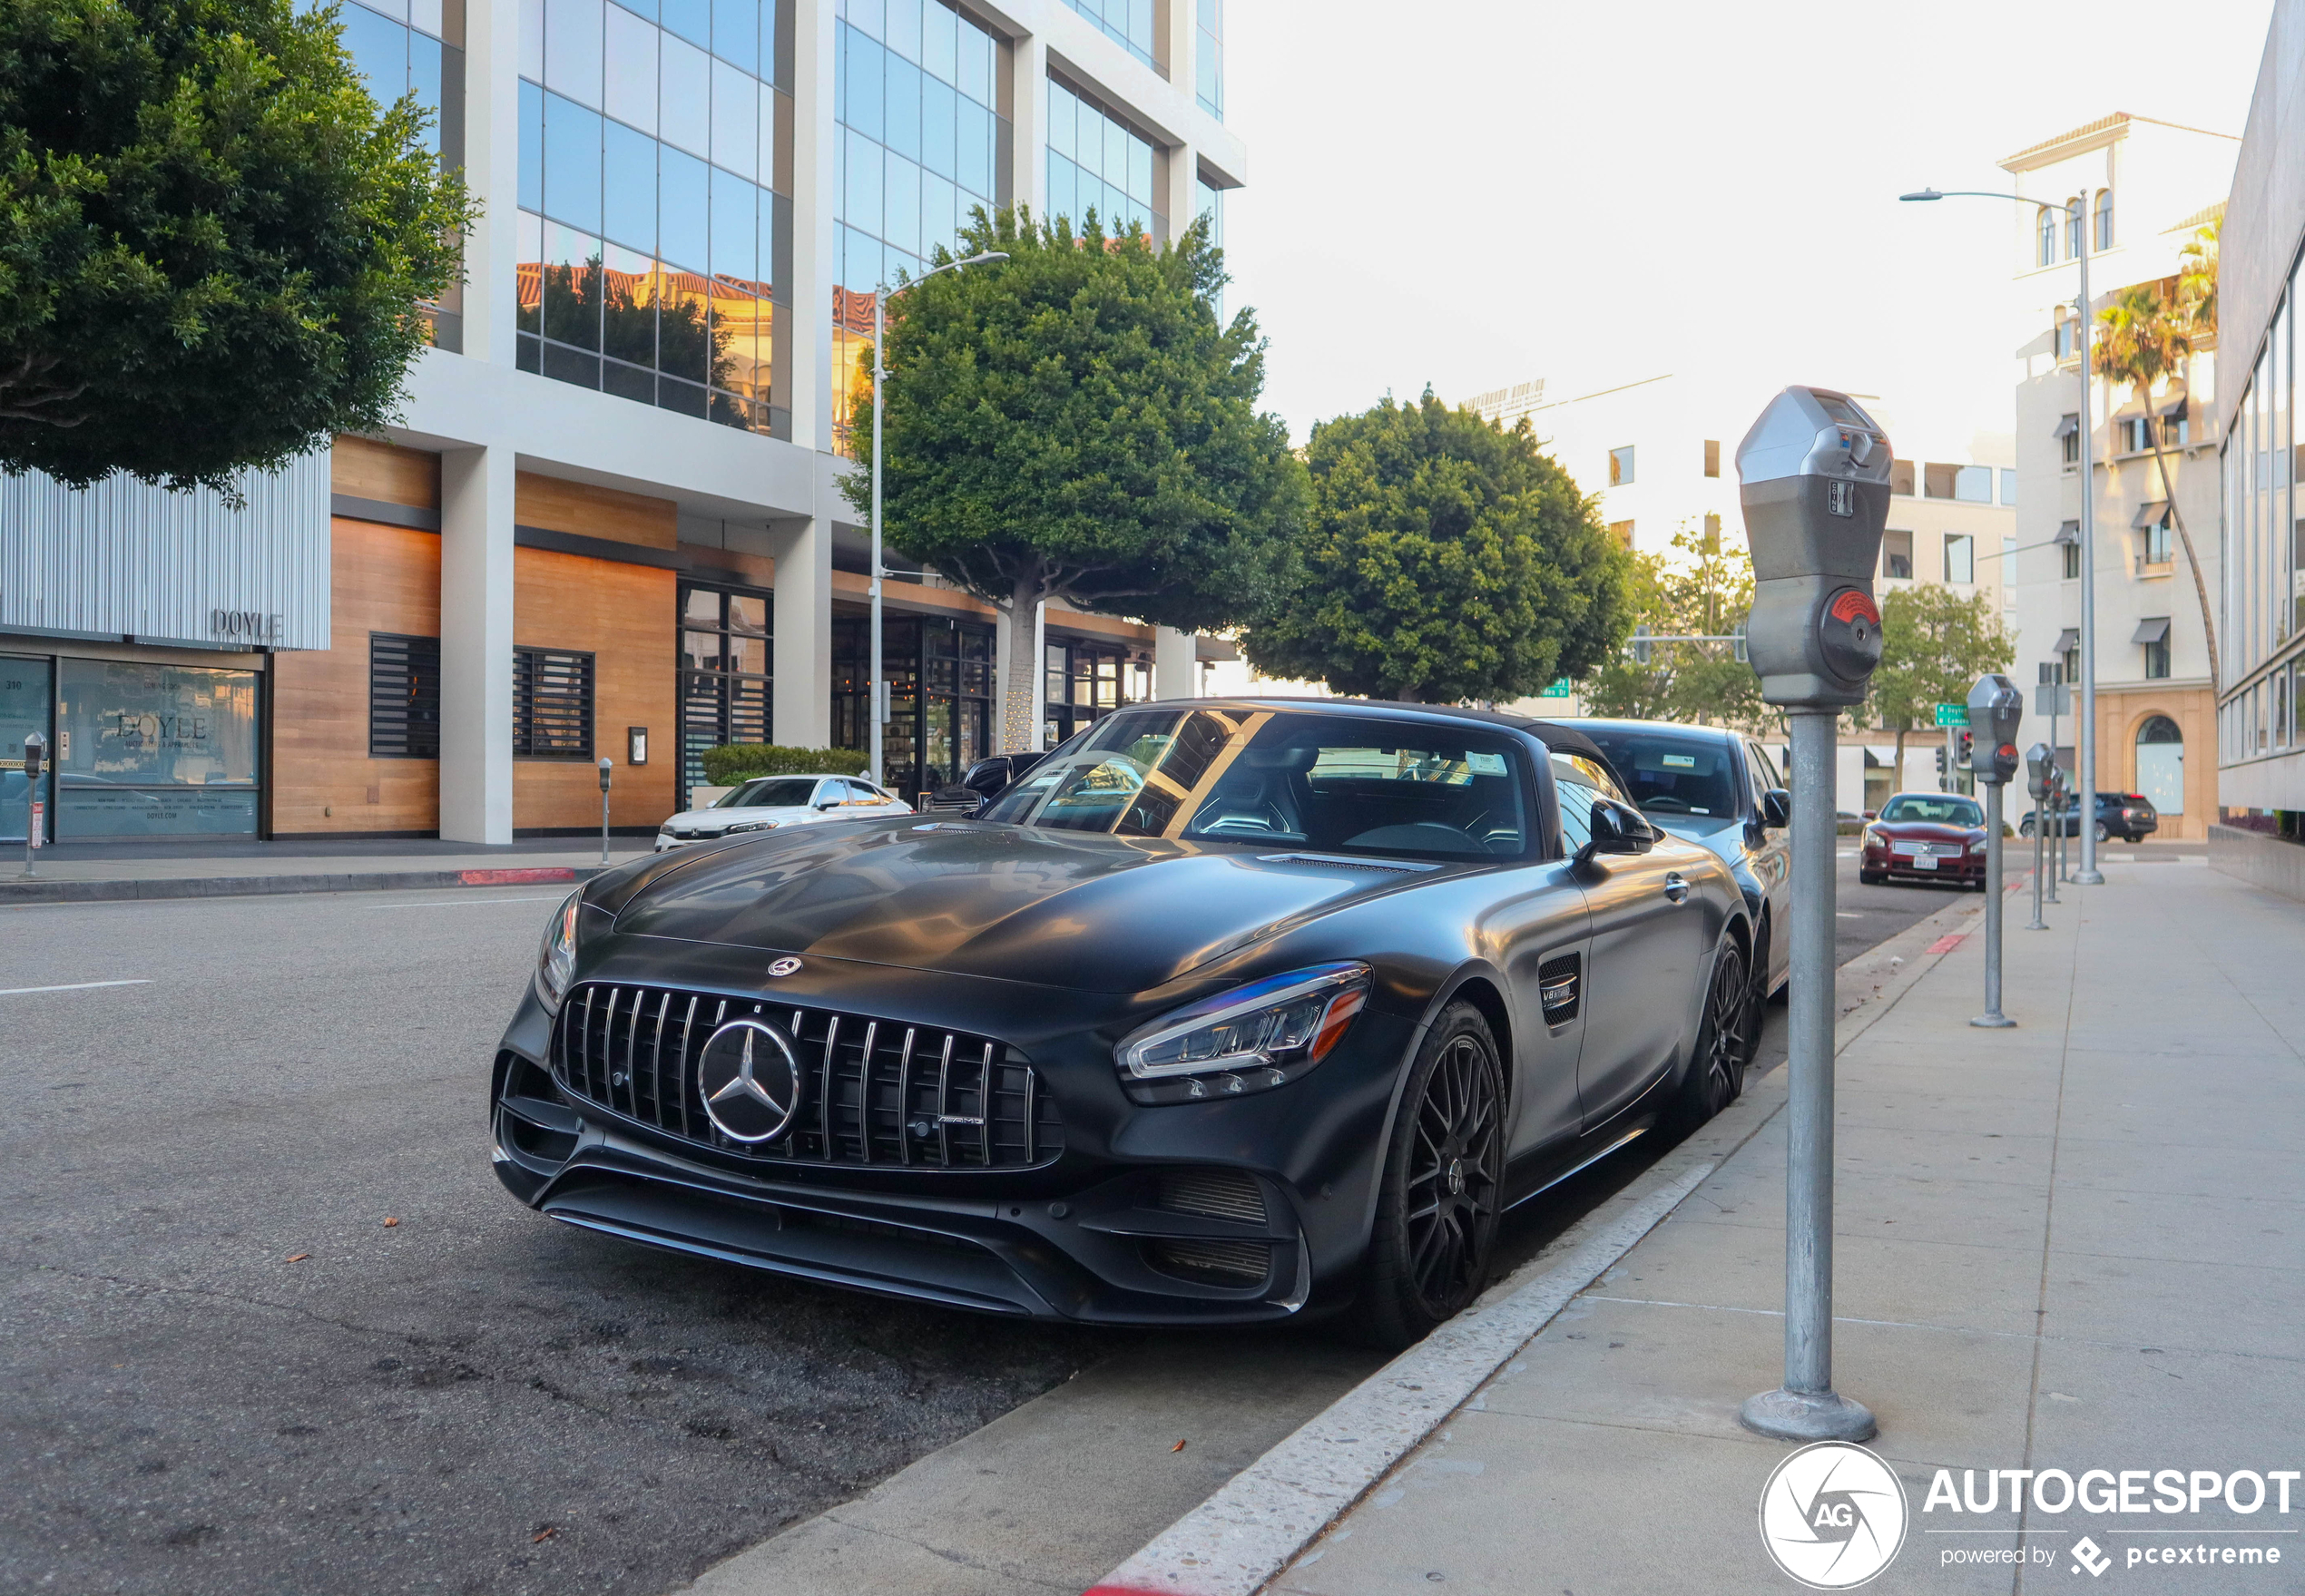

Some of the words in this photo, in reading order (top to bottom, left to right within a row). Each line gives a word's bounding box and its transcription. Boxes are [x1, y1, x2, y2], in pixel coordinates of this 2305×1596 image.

[213, 609, 283, 638] DOYLE
[6, 681, 22, 690] 310
[117, 715, 206, 739] DOYLE
[1544, 991, 1554, 1001] V8
